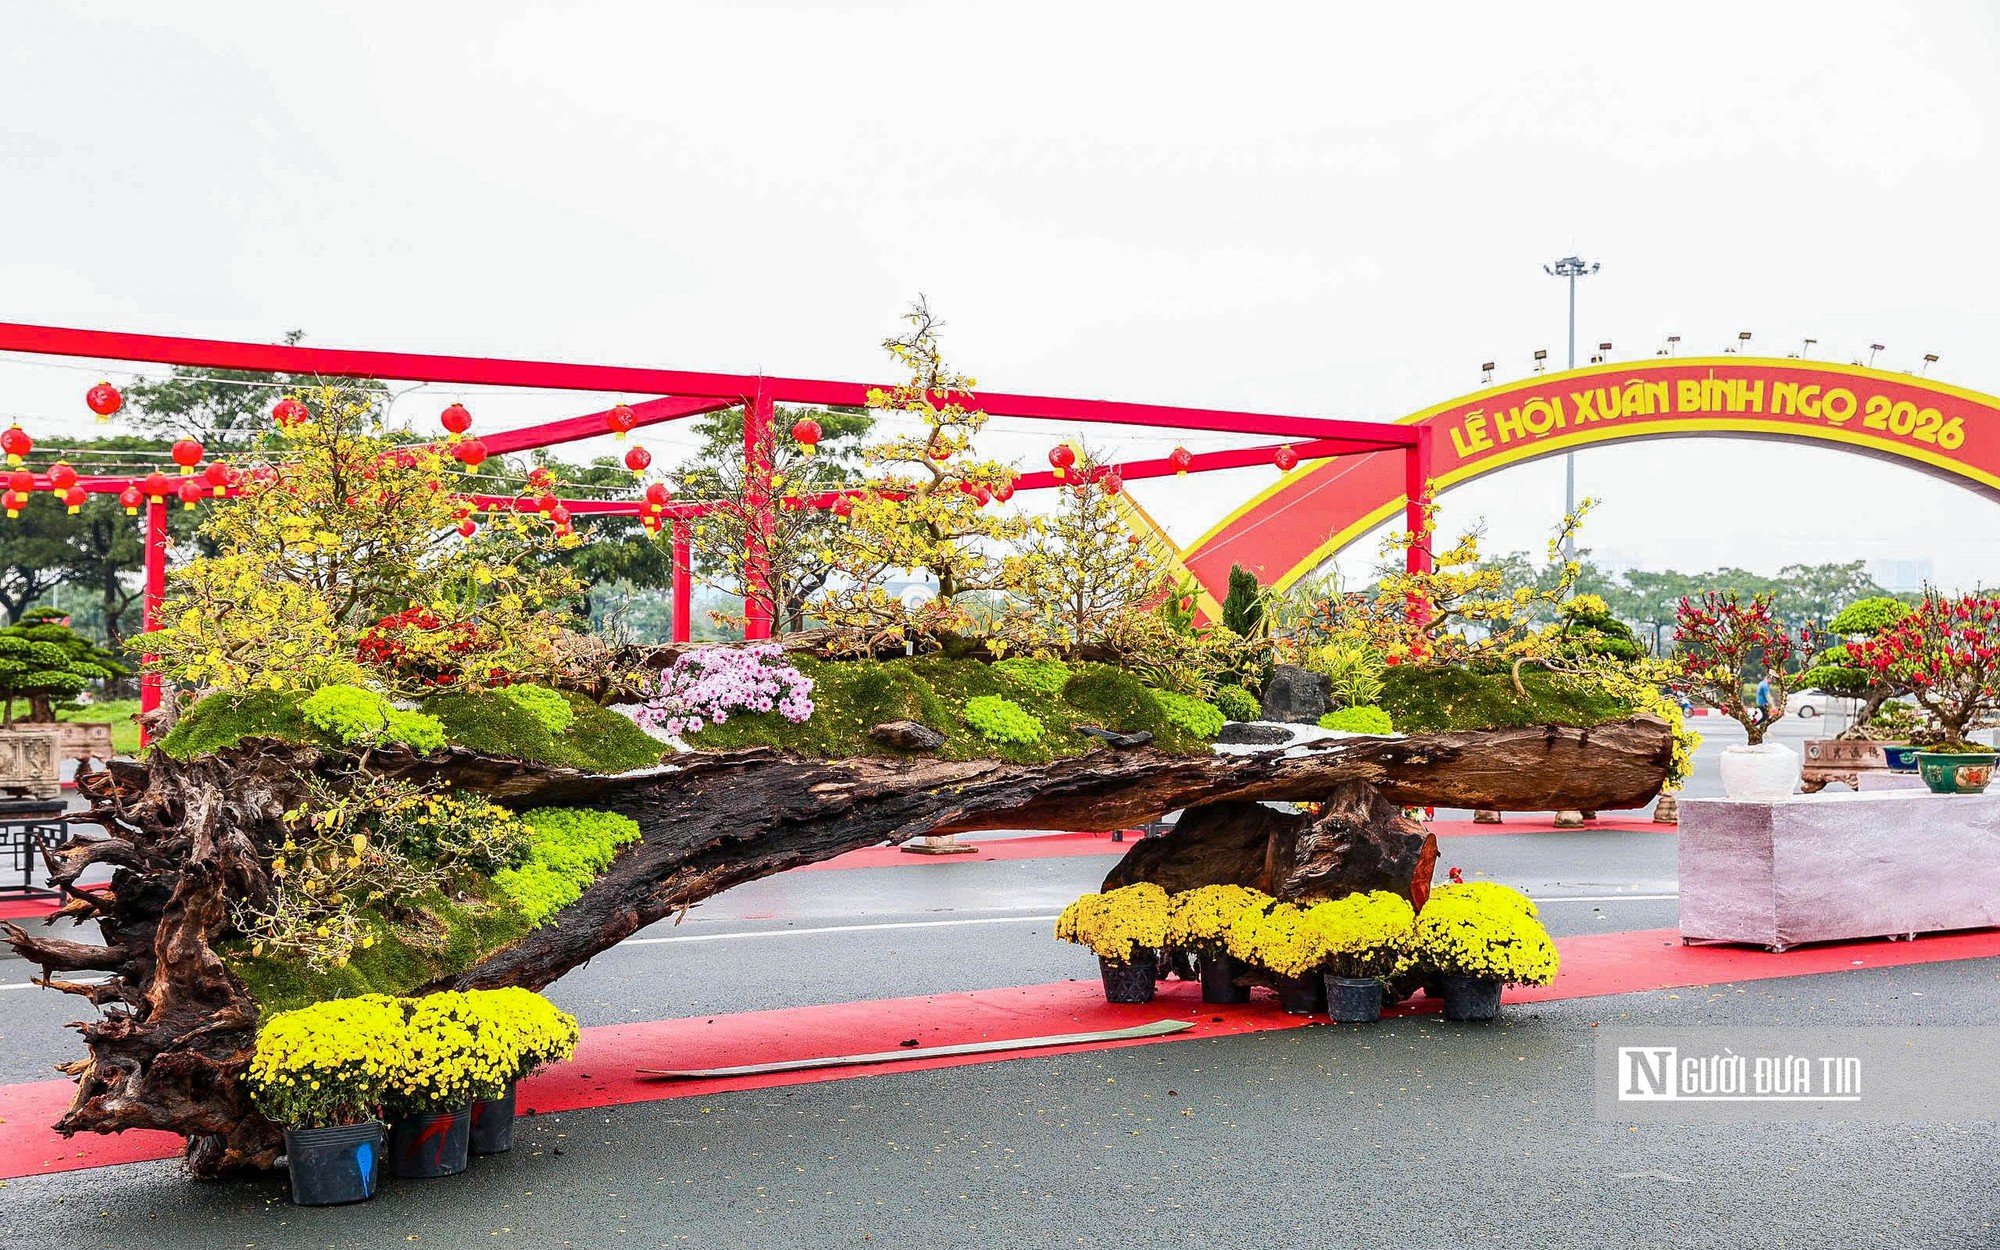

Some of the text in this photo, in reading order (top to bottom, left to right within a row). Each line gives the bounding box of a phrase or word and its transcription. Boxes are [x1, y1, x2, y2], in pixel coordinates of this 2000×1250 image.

[1449, 368, 1965, 459] LỄ HỘI XUÂN BÍNH NGỌ 2026
